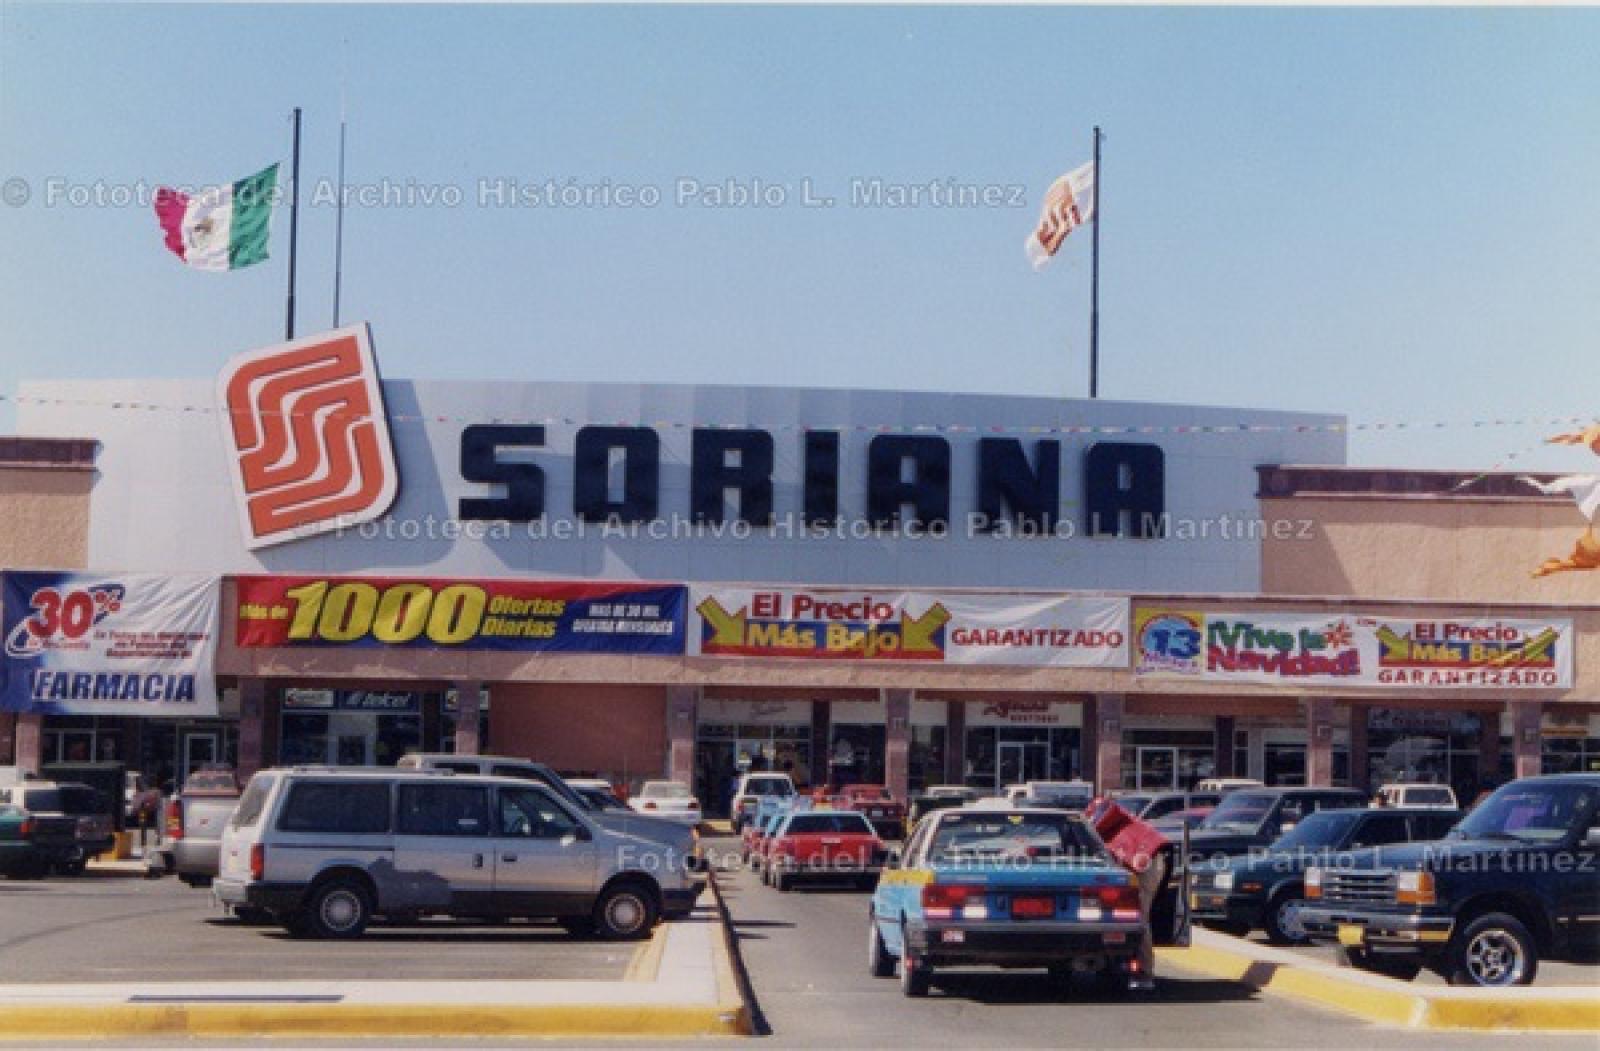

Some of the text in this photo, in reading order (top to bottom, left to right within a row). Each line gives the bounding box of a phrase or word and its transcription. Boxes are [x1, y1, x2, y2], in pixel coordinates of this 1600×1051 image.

[458, 424, 1165, 539] SORIANA
[287, 580, 486, 644] 1000
[752, 593, 894, 620] El Precio
[750, 622, 900, 656] Más Bajo
[951, 628, 1124, 649] GARANTIZADO
[1152, 628, 1202, 659] 13
[1415, 622, 1518, 641] El Precio
[1413, 642, 1462, 661] Más
[31, 671, 196, 702] FARMACIA
[1378, 669, 1557, 685] GARANTIZADO
